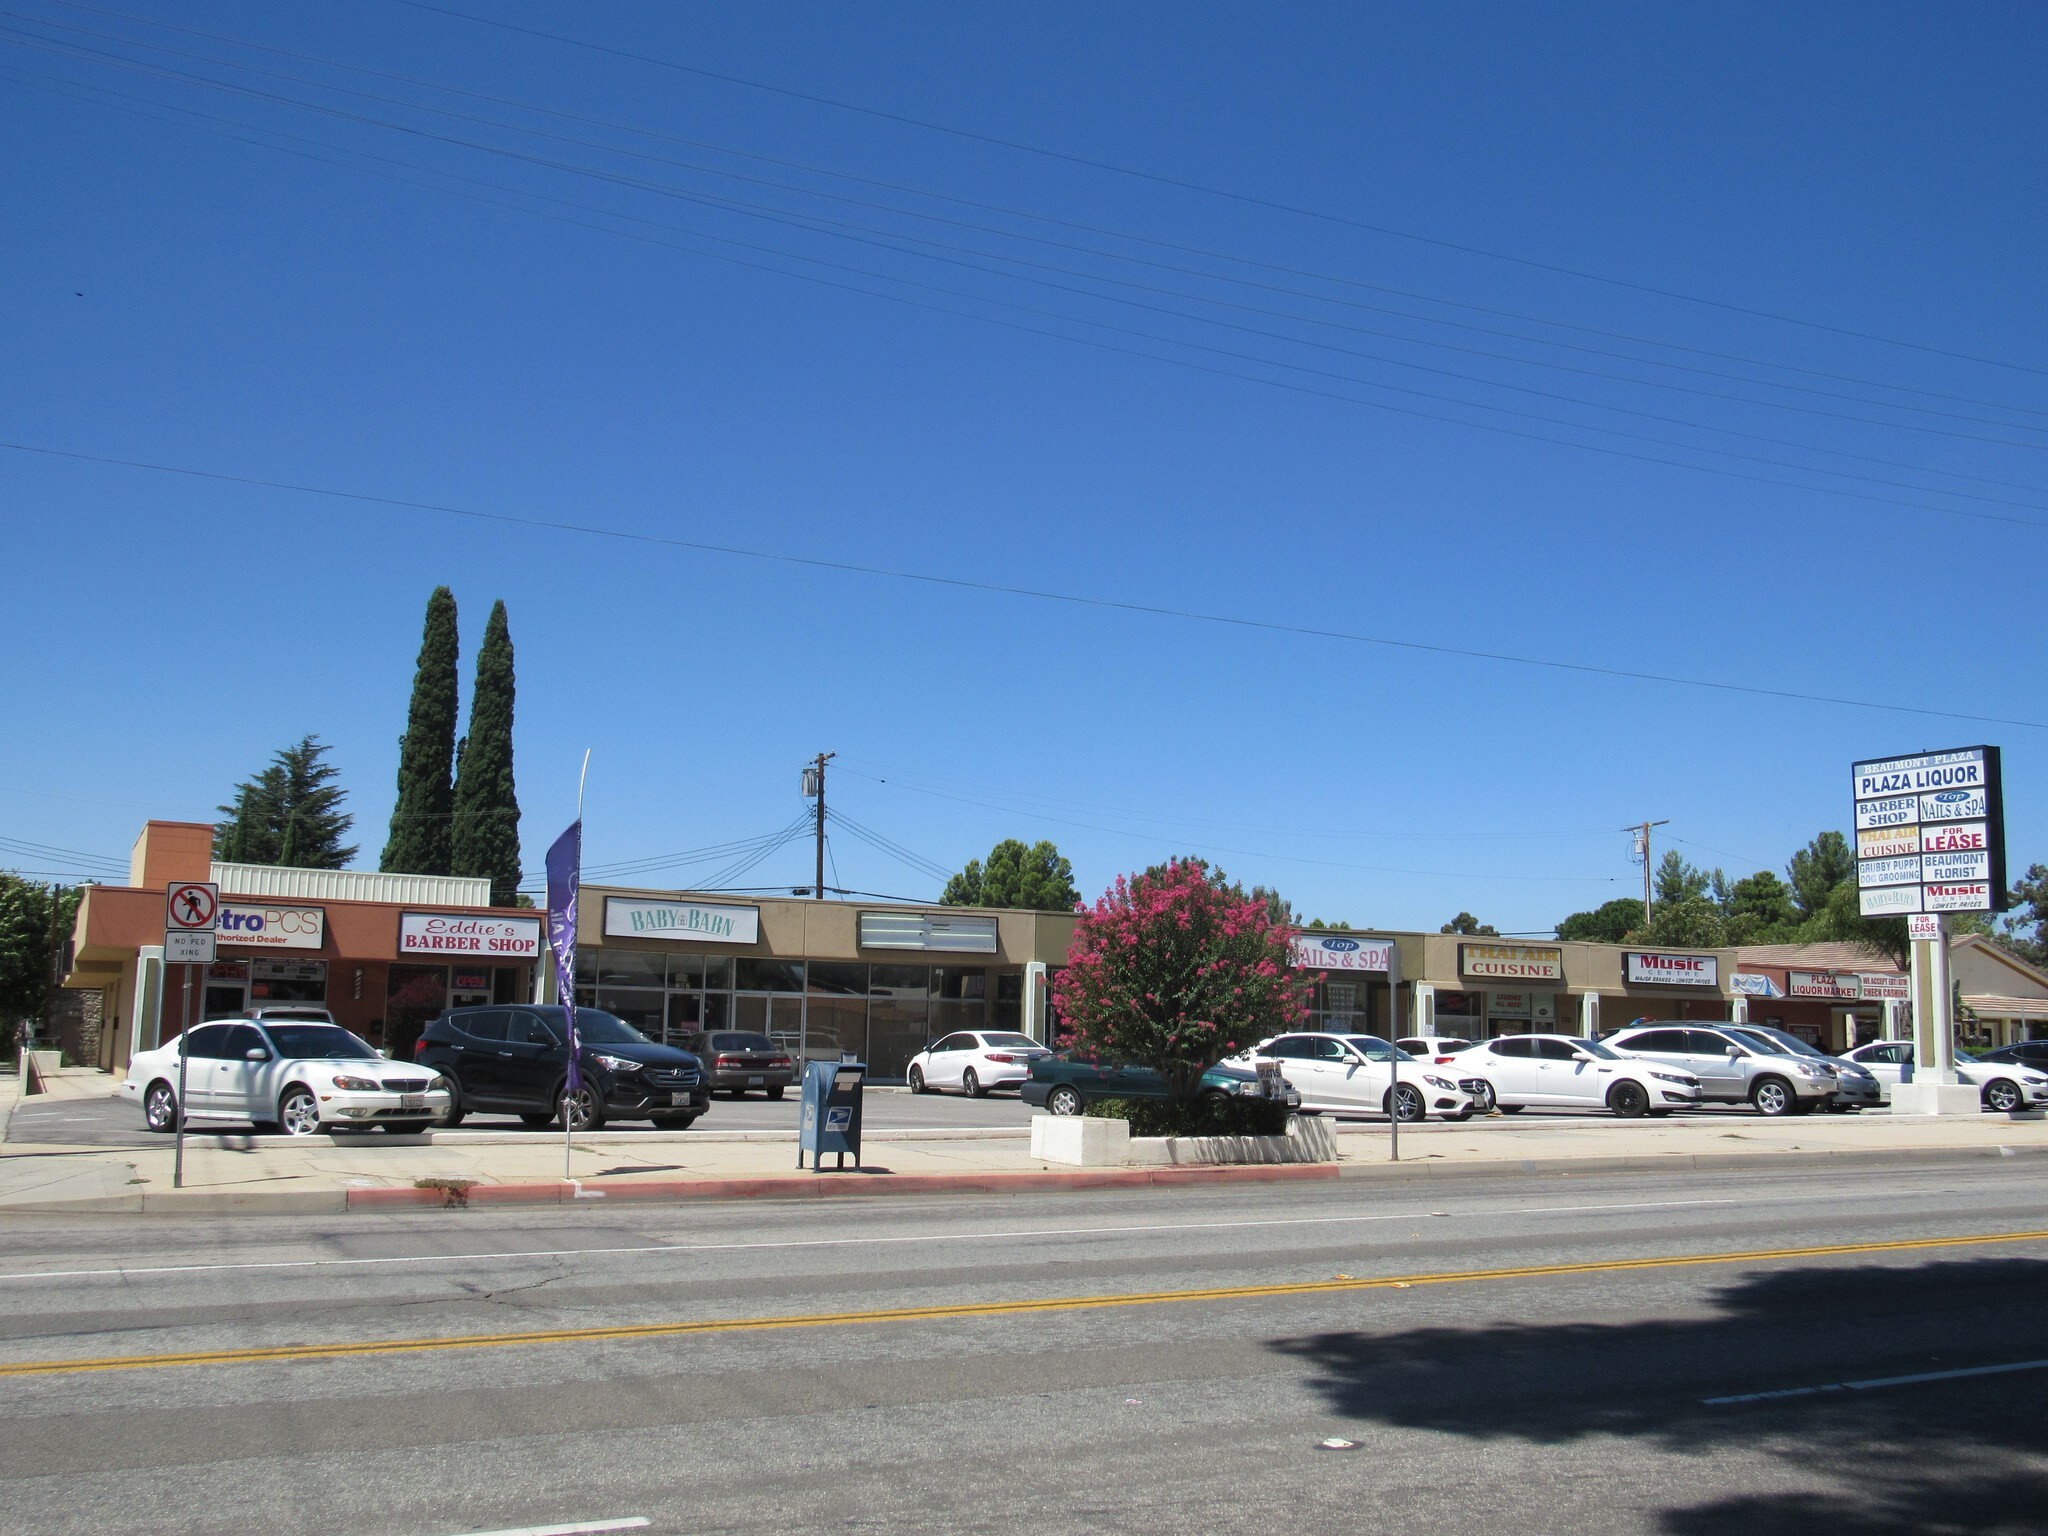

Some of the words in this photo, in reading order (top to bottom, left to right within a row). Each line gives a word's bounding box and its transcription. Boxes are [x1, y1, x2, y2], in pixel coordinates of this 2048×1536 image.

[1863, 757, 1928, 774] BEAUMONT
[1934, 751, 1974, 765] PLAZA
[1862, 773, 1911, 794] PLAZA
[1916, 765, 1978, 788] LIQUOR
[1940, 792, 1965, 803] Top
[1860, 798, 1915, 815] BARBER
[1921, 800, 1951, 820] NAILS
[1954, 803, 1962, 817] &
[1965, 796, 1986, 816] SPA
[1869, 812, 1908, 826] SHOP
[1860, 828, 1893, 842] THAI
[1895, 826, 1918, 839] AIR
[1942, 827, 1963, 835] FOR
[1925, 833, 1982, 851] LEASE
[1863, 843, 1915, 858] CUISINE
[1860, 861, 1891, 873] GRUBBY
[1893, 858, 1919, 870] PUPPY
[1925, 853, 1985, 867] BEAUMONT
[1878, 870, 1920, 882] GROOMING
[1934, 867, 1976, 879] FLORIST
[1927, 884, 1986, 896] Music
[1866, 893, 1888, 909] BABY
[1893, 891, 1915, 907] BARN
[217, 908, 319, 934] troPCS
[425, 918, 514, 936] Eddie's
[631, 909, 678, 932] BABY
[689, 908, 735, 937] BARN
[1910, 923, 1936, 932] LEASE
[190, 938, 206, 946] PED
[216, 933, 255, 942] thorized
[257, 935, 288, 944] Dealer
[405, 934, 480, 950] BARBER
[488, 938, 536, 952] SHOP
[1326, 939, 1354, 951] Top
[1301, 947, 1337, 968] AILS
[1341, 953, 1355, 968] &
[1358, 948, 1389, 969] SPA
[1467, 946, 1517, 960] THAI
[1521, 948, 1559, 962] AIR
[1472, 962, 1554, 976] CUISINE
[1640, 955, 1704, 971] Music
[1811, 975, 1837, 985] PLAZA
[1496, 993, 1522, 1001] LESSONS
[1792, 985, 1823, 995] LIQUOR
[1824, 986, 1857, 997] MARKET
[1863, 988, 1882, 997] CHECK
[1883, 989, 1908, 998] CASHING
